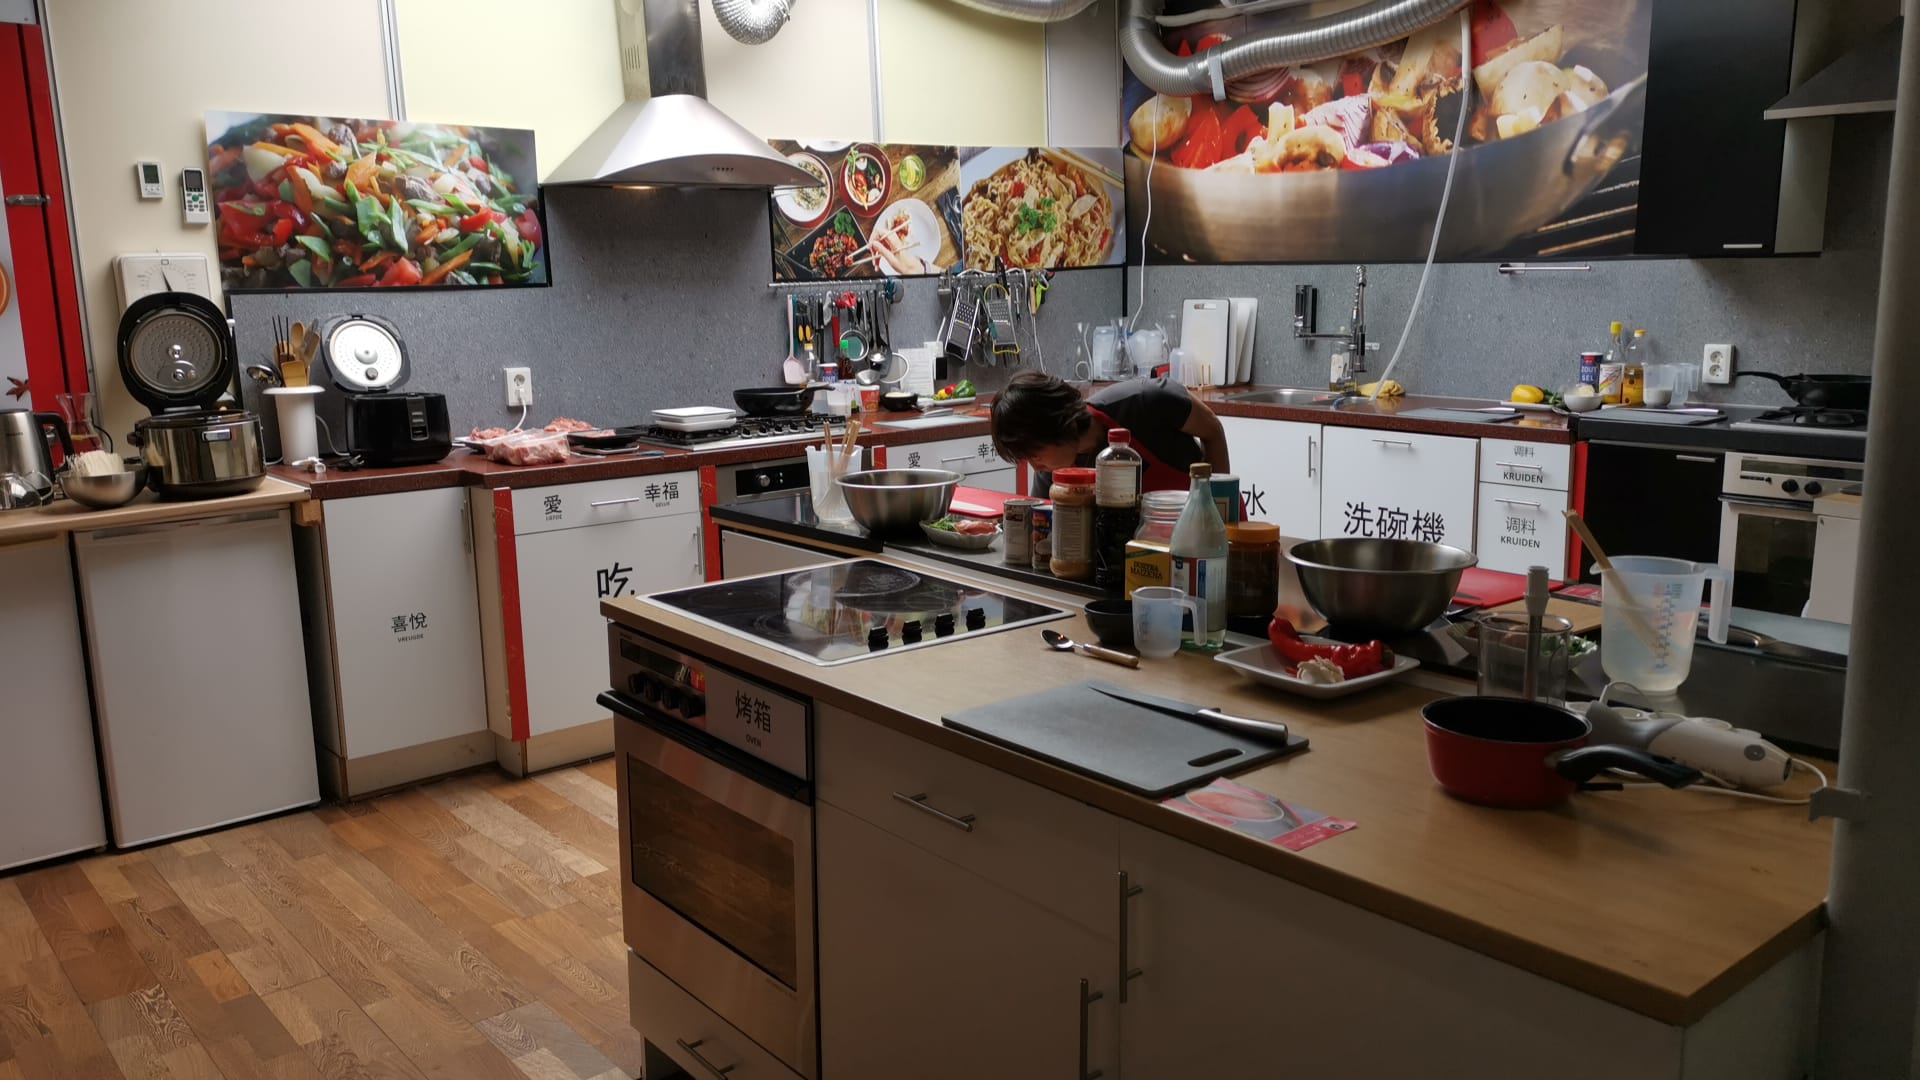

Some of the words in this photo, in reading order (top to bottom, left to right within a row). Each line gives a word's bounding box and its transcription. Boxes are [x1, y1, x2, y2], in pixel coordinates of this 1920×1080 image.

[1503, 471, 1544, 484] KRUIDEN
[644, 481, 680, 502] 幸福
[1241, 483, 1267, 516] 水
[543, 494, 562, 515] 愛
[1343, 501, 1445, 544] 洗碗機
[1506, 516, 1536, 536] 调料
[1500, 535, 1540, 549] KRUIDEN
[735, 690, 771, 734] 烤箱
[745, 733, 762, 748] OVEN
